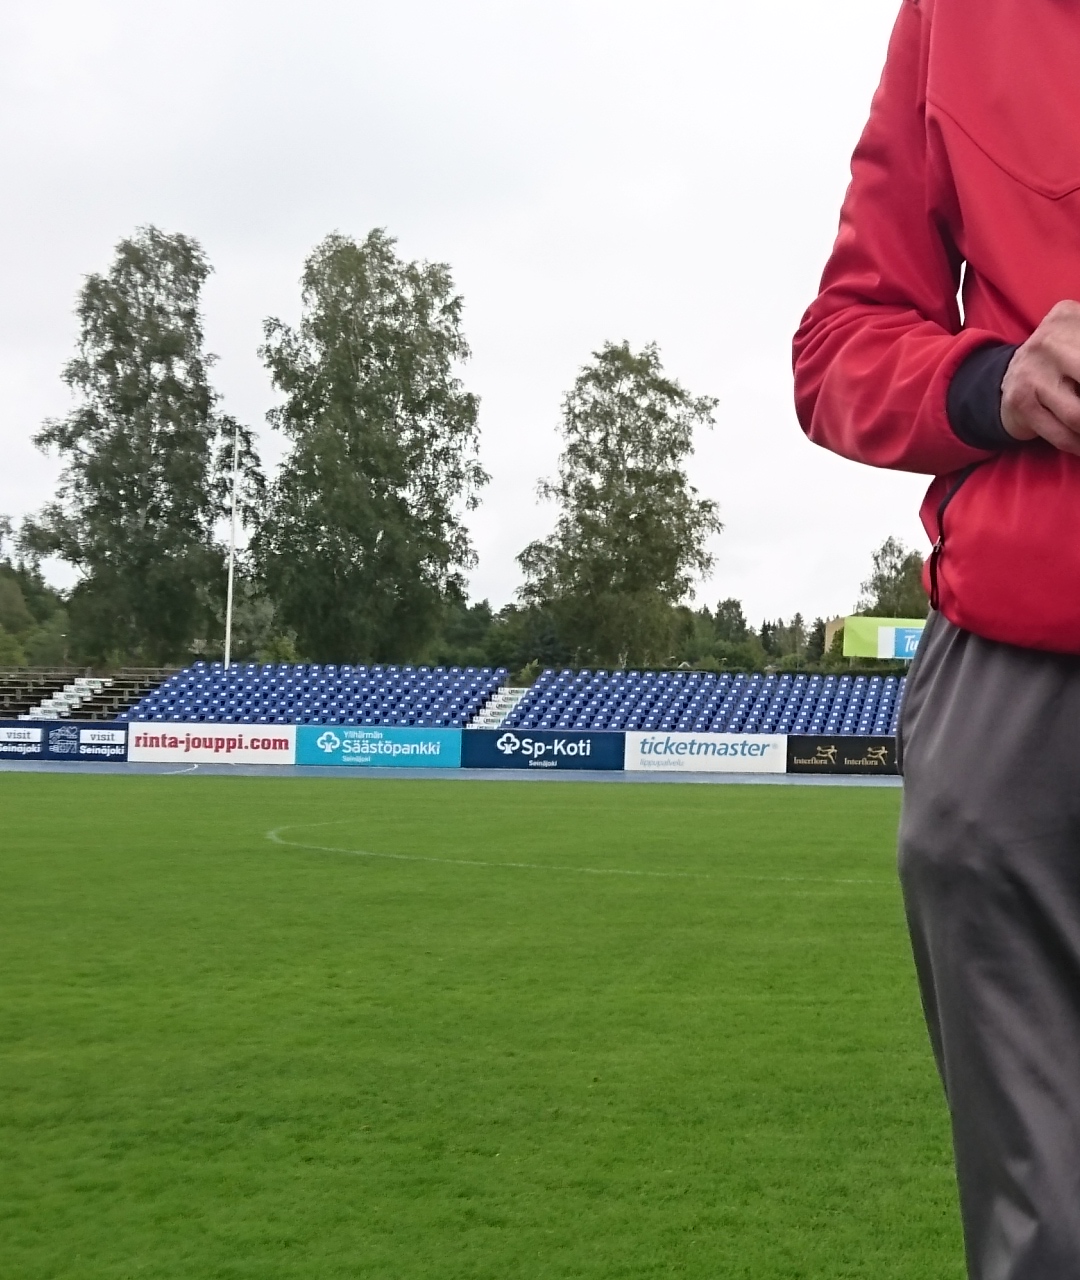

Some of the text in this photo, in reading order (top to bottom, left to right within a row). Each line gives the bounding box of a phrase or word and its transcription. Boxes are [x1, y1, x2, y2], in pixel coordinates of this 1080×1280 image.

[6, 730, 31, 739] visit
[90, 732, 115, 741] visit
[135, 733, 289, 752] rinta-jouppi.com
[80, 745, 124, 756] Seinäjoki
[342, 740, 441, 756] Säästöpankki
[521, 738, 591, 758] Sp-Koti
[793, 757, 828, 765] Interflora
[844, 757, 878, 766] Interflora
